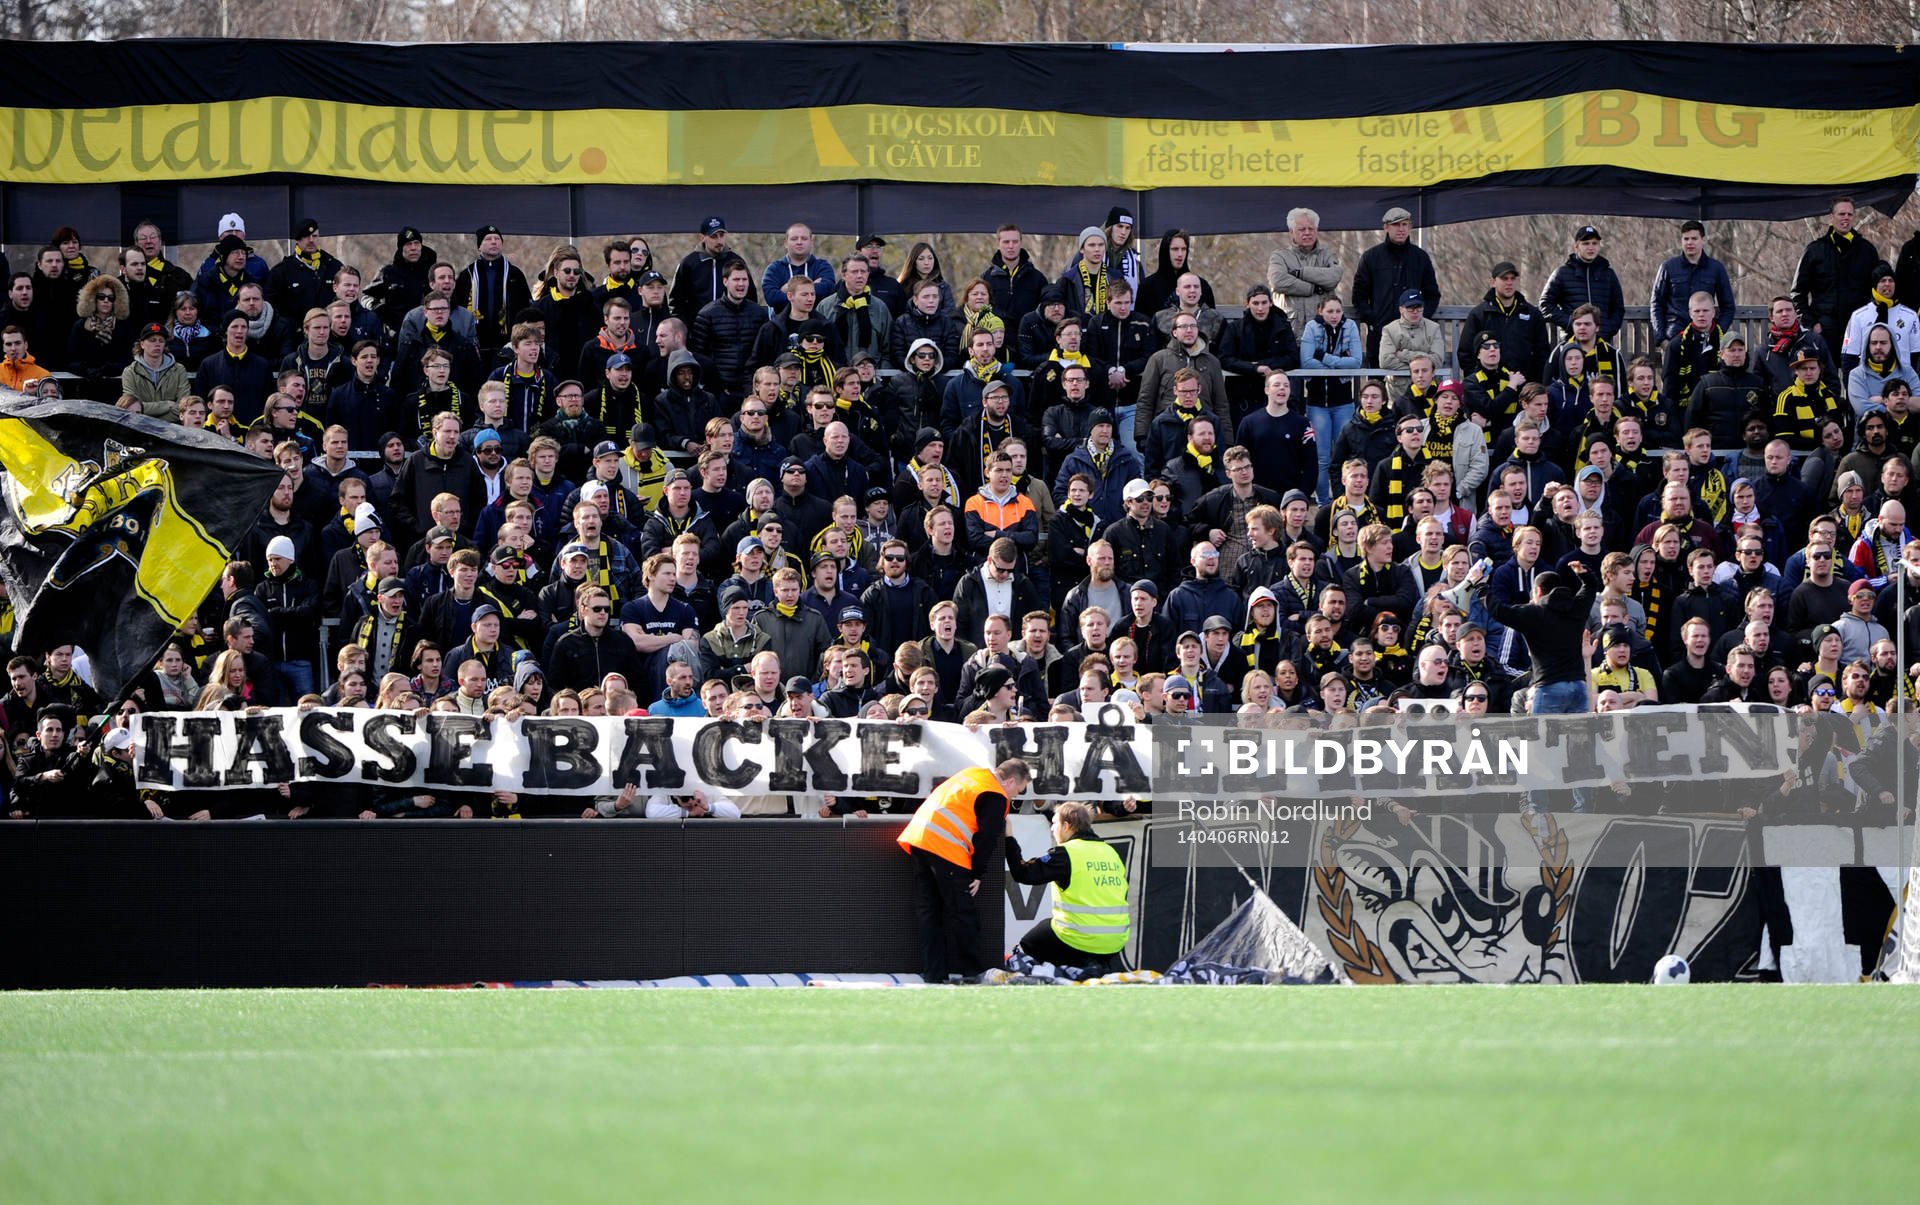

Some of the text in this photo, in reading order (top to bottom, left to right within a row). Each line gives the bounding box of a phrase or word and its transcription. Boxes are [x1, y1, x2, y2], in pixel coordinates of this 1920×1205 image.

[867, 109, 1057, 138] HÖGSKOLAN
[1575, 90, 1765, 148] BIG
[1823, 126, 1848, 137] MOT
[867, 139, 981, 168] I GÄVLE
[1146, 144, 1304, 180] fastigheter
[1357, 145, 1514, 181] fastigheter
[138, 712, 493, 787] HASSE
